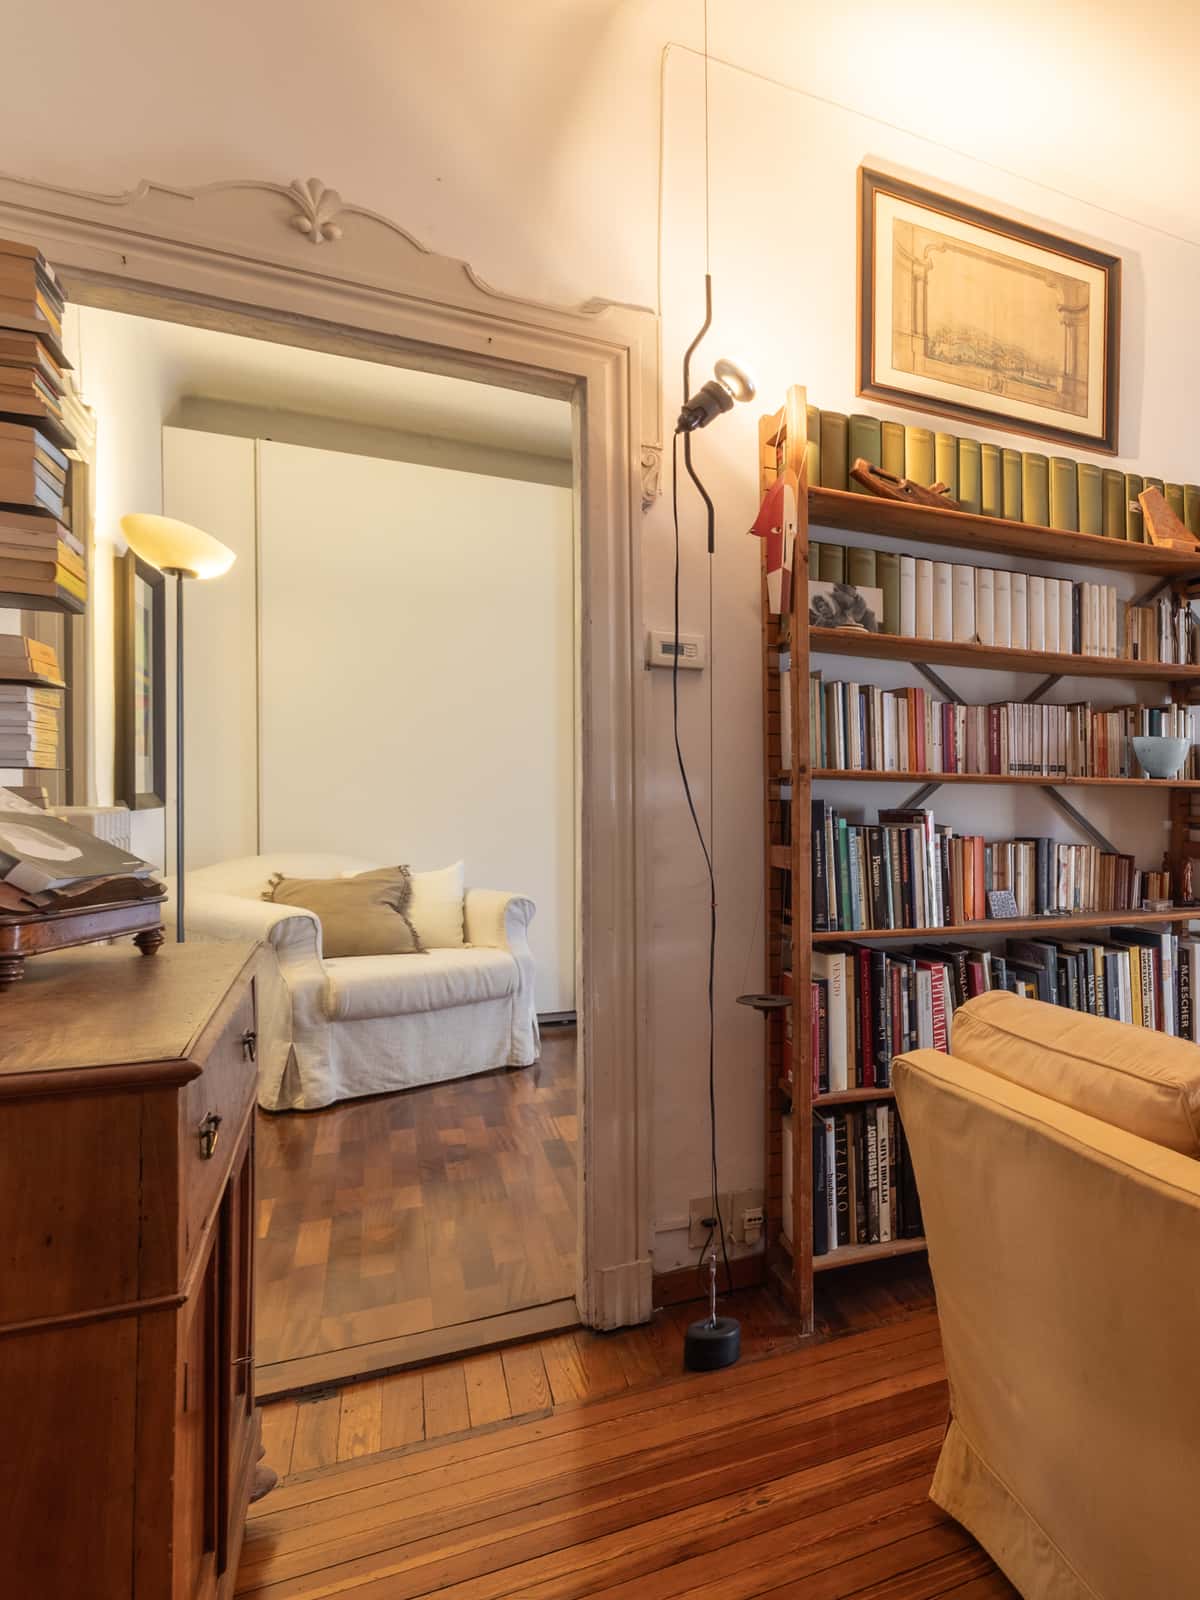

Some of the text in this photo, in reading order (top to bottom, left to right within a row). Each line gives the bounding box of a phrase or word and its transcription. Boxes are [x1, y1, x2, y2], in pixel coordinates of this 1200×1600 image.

[872, 855, 881, 886] Picasso
[931, 966, 944, 980] LA
[1180, 964, 1190, 1028] M.C.ESCHER
[932, 981, 946, 1029] PITTURA
[836, 1125, 848, 1212] TIZIANO
[867, 1125, 878, 1188] REMBRANDT
